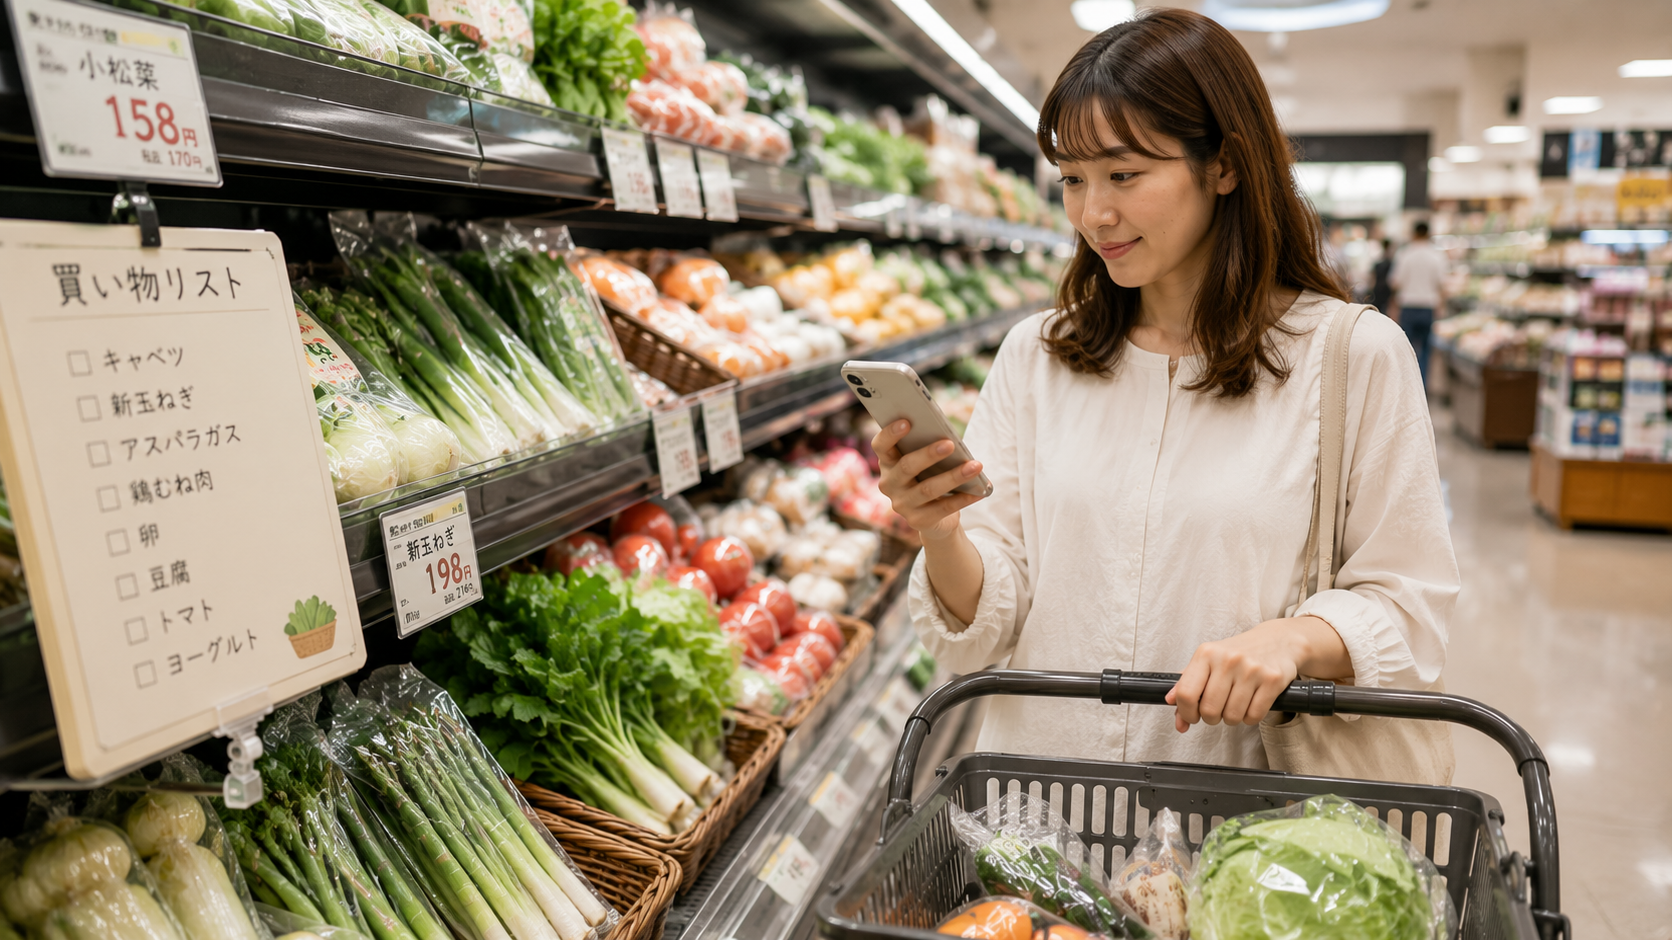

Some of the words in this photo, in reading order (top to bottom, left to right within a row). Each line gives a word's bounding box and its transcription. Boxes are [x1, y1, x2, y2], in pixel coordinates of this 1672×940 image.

[79, 49, 160, 92] 小松菜
[105, 95, 199, 148] 158円
[167, 150, 202, 168] 170円
[51, 262, 243, 307] 買い物リスト
[103, 344, 185, 374] キャベツ
[111, 385, 195, 420] 新玉ねぎ
[119, 423, 242, 463] アスパラガス
[129, 469, 214, 507] 鶏むね肉
[138, 523, 160, 550] 卵
[406, 525, 455, 562] 新玉ねぎ
[149, 559, 191, 593] 豆腐
[425, 552, 472, 595] 198円
[161, 598, 214, 635] トマト
[167, 629, 259, 678] ヨーグルト
